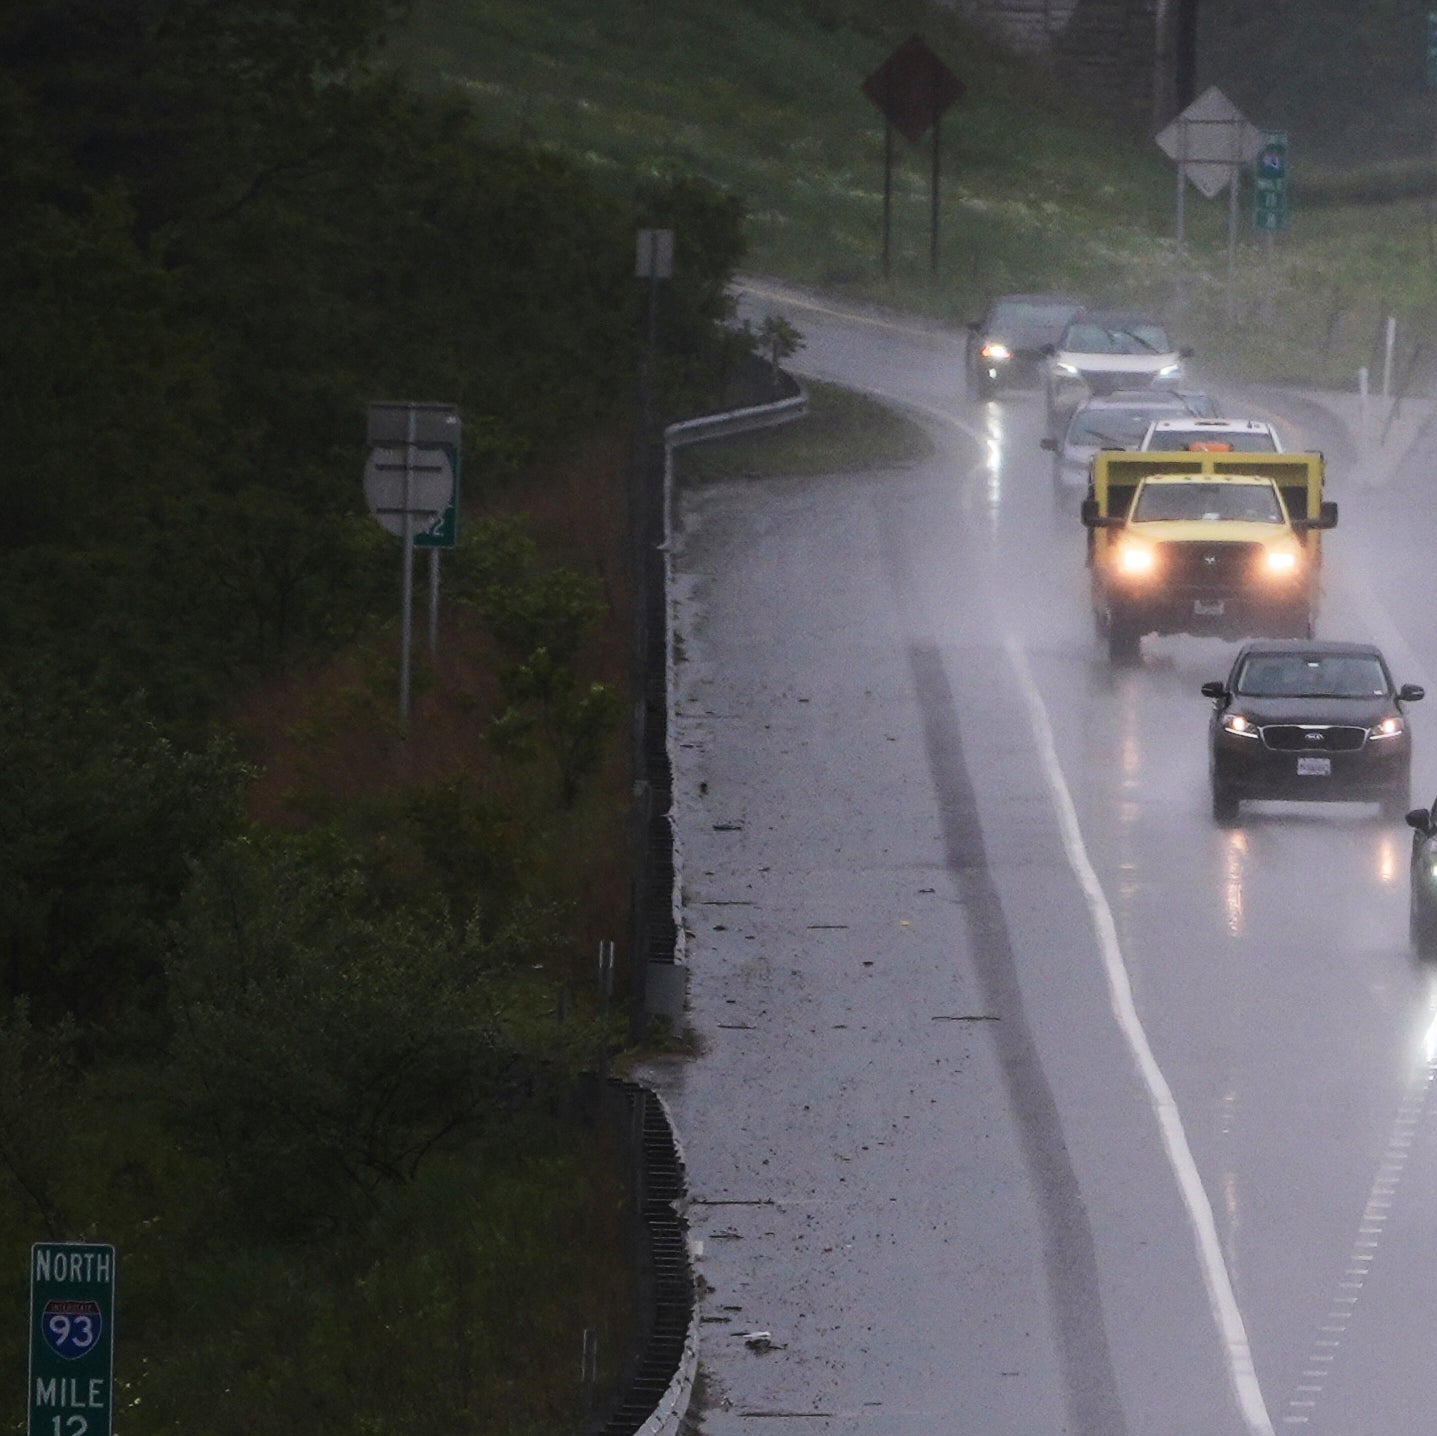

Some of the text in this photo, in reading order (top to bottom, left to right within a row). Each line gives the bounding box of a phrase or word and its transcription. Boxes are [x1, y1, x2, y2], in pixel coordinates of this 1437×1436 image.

[37, 1250, 110, 1283] NORTH
[49, 1315, 93, 1347] 93
[36, 1377, 104, 1408] MILE
